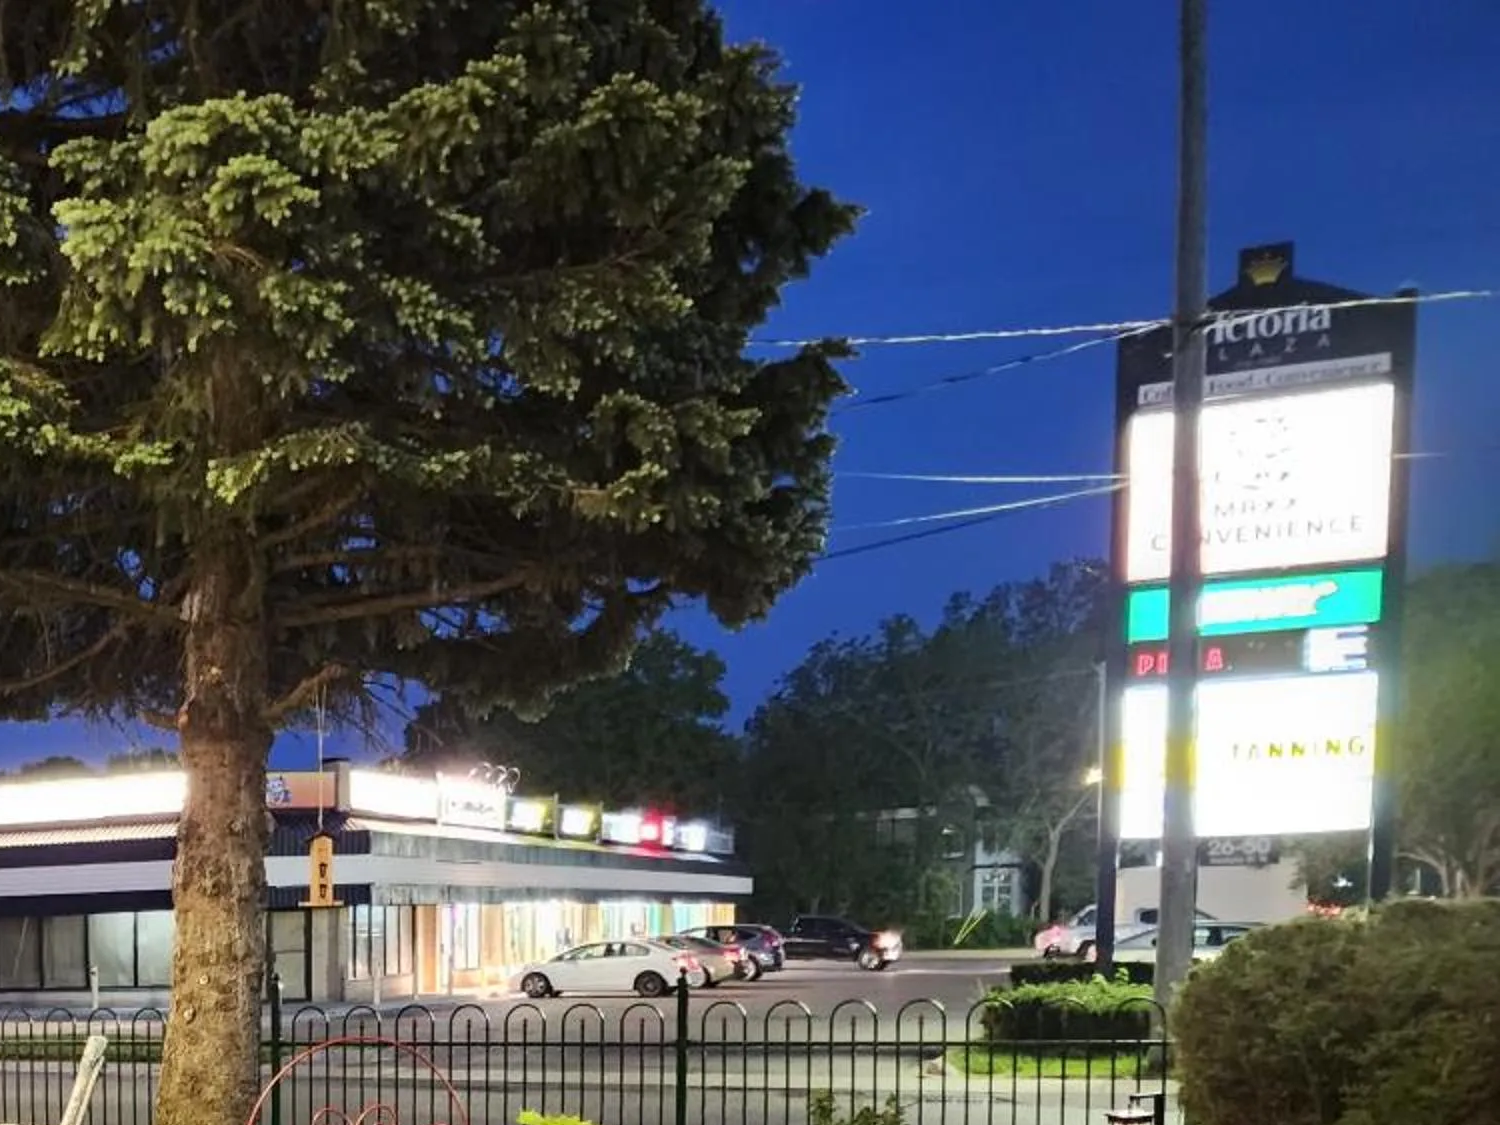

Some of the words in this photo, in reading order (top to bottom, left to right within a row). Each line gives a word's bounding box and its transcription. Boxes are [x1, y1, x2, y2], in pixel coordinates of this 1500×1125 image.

[1204, 302, 1332, 344] ictoria
[1217, 334, 1331, 361] LAZA
[1151, 514, 1364, 551] CNVENIENCE
[1136, 647, 1225, 676] PIA
